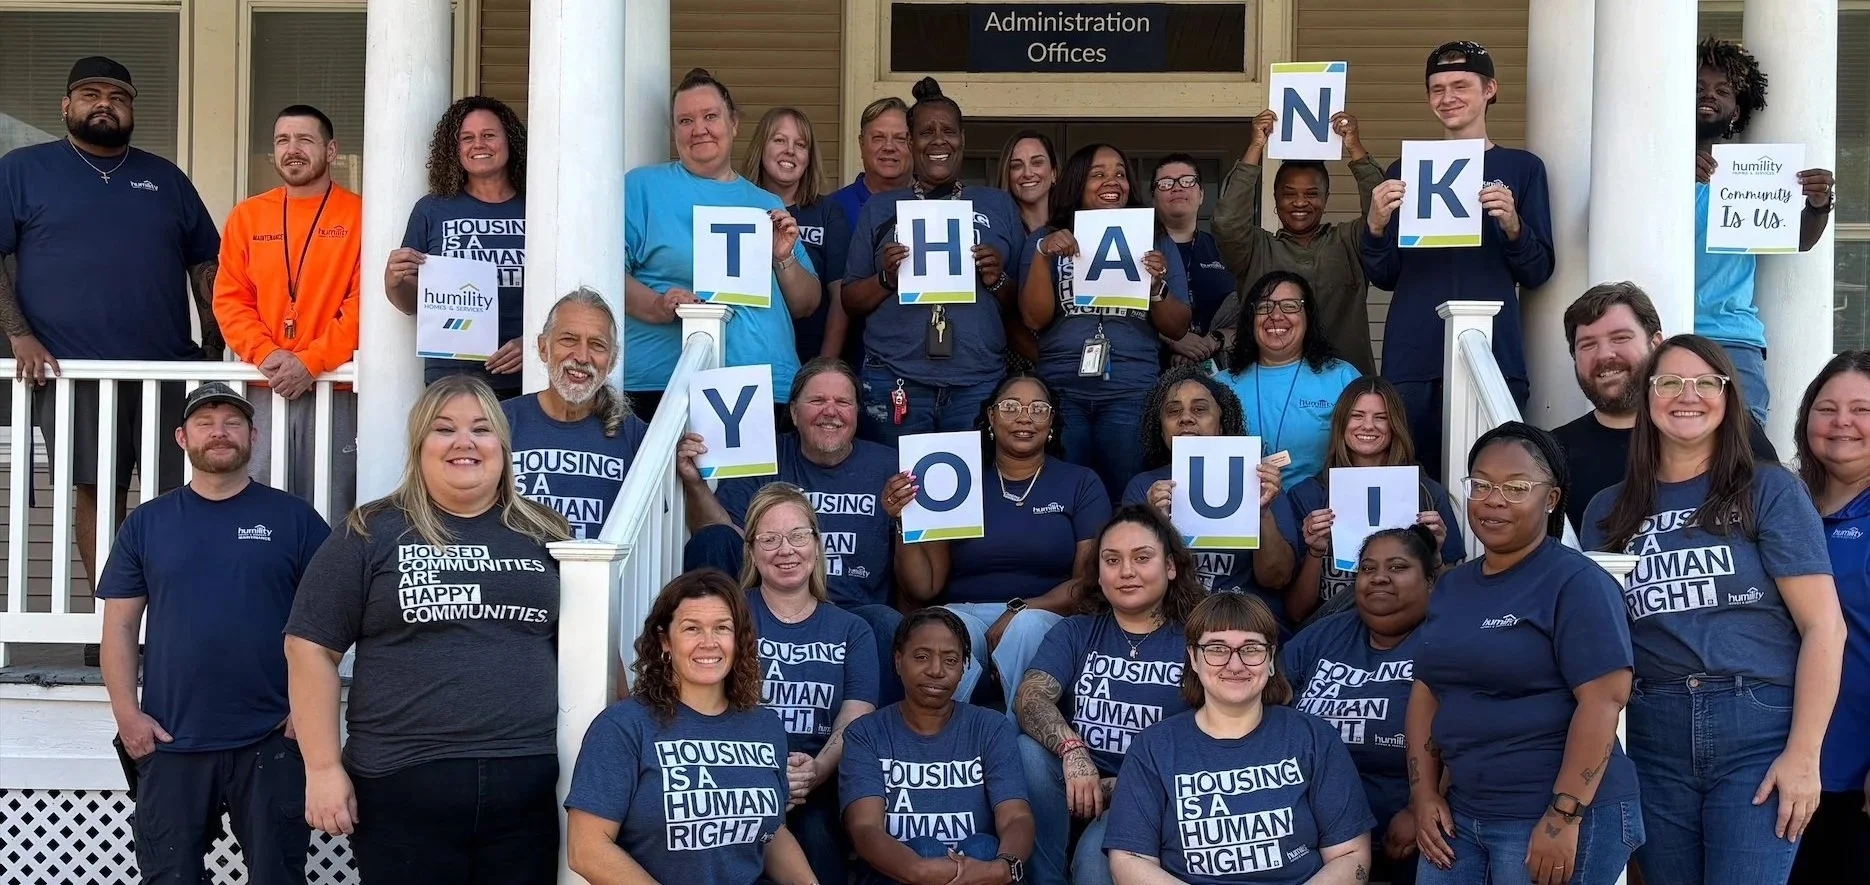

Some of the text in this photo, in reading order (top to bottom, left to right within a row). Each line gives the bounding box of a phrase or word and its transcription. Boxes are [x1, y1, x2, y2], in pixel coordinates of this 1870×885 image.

[984, 11, 1150, 32] Administration
[1027, 42, 1107, 63] Offices
[1280, 87, 1332, 143] N
[1732, 160, 1783, 173] humility
[1416, 158, 1471, 219] K
[1720, 187, 1793, 203] Community
[444, 219, 526, 236] HOUSIN
[1720, 205, 1787, 229] Is Us.
[442, 235, 483, 251] IS A
[710, 223, 756, 278] T
[911, 218, 962, 277] H
[1084, 225, 1141, 282] A
[424, 288, 493, 311] humility
[702, 384, 759, 449] Y
[514, 473, 551, 496] S A
[911, 451, 972, 512] O
[1188, 456, 1245, 519] U
[812, 494, 874, 515] USING
[238, 527, 272, 537] humility
[402, 546, 486, 559] HOUSED
[1640, 534, 1662, 556] A
[398, 559, 546, 573] COMMUNITIES
[398, 571, 441, 588] ARE
[402, 586, 475, 605] HAPPY
[1626, 580, 1714, 620] RIGHT.
[1728, 591, 1765, 602] humility
[402, 604, 549, 624] COMMUNITIES.
[759, 641, 846, 662] OUSING
[766, 659, 784, 680] A
[760, 682, 832, 707] UMAN
[1094, 677, 1110, 700] A
[1321, 683, 1340, 699] A
[1076, 697, 1160, 728] HUMAN
[1374, 734, 1405, 746] humili
[658, 741, 776, 767] HOUSING
[662, 766, 718, 792] IS A
[1177, 761, 1302, 797] HOUSING
[667, 789, 777, 820] HUMAN
[893, 788, 914, 813] A
[1177, 793, 1231, 821] IS A
[669, 819, 758, 849] RIGHT.
[886, 814, 973, 840] UMAN
[1181, 809, 1292, 848] HUMAN
[1186, 843, 1280, 874] RIGHT.
